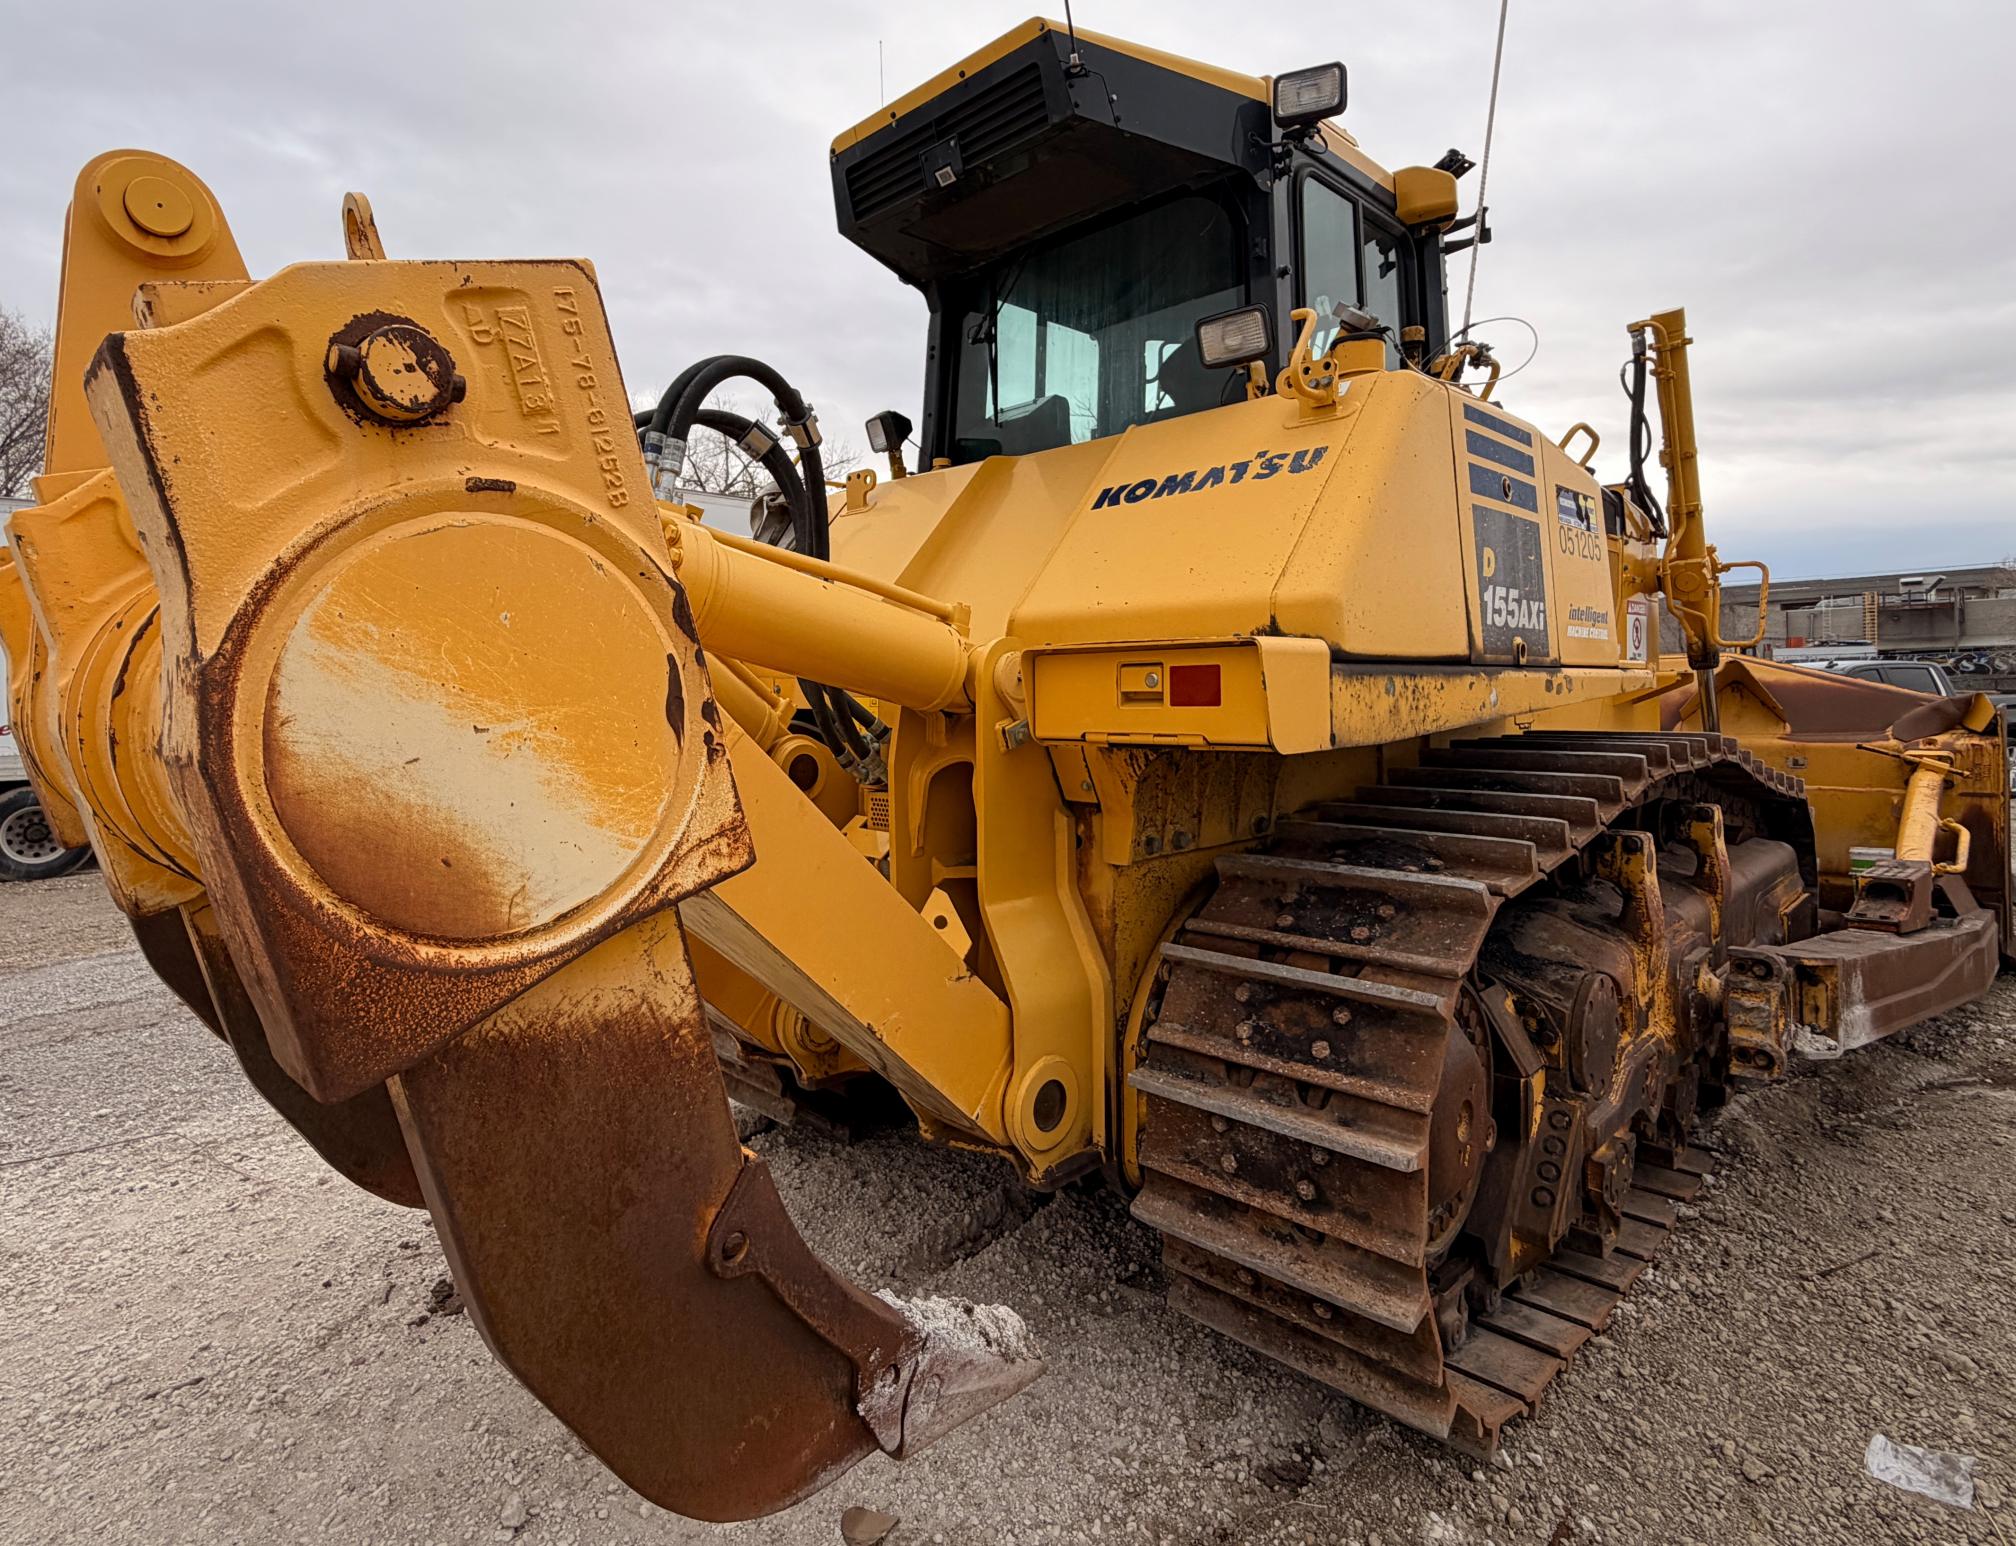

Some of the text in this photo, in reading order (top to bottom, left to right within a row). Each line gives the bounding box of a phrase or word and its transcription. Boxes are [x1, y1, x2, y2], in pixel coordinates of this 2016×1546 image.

[1090, 446, 1329, 510] KOMATSU
[1483, 546, 1496, 577] D
[1559, 525, 1602, 562] 051205
[1483, 585, 1544, 630] 155AXi
[1568, 603, 1609, 627] intelligent
